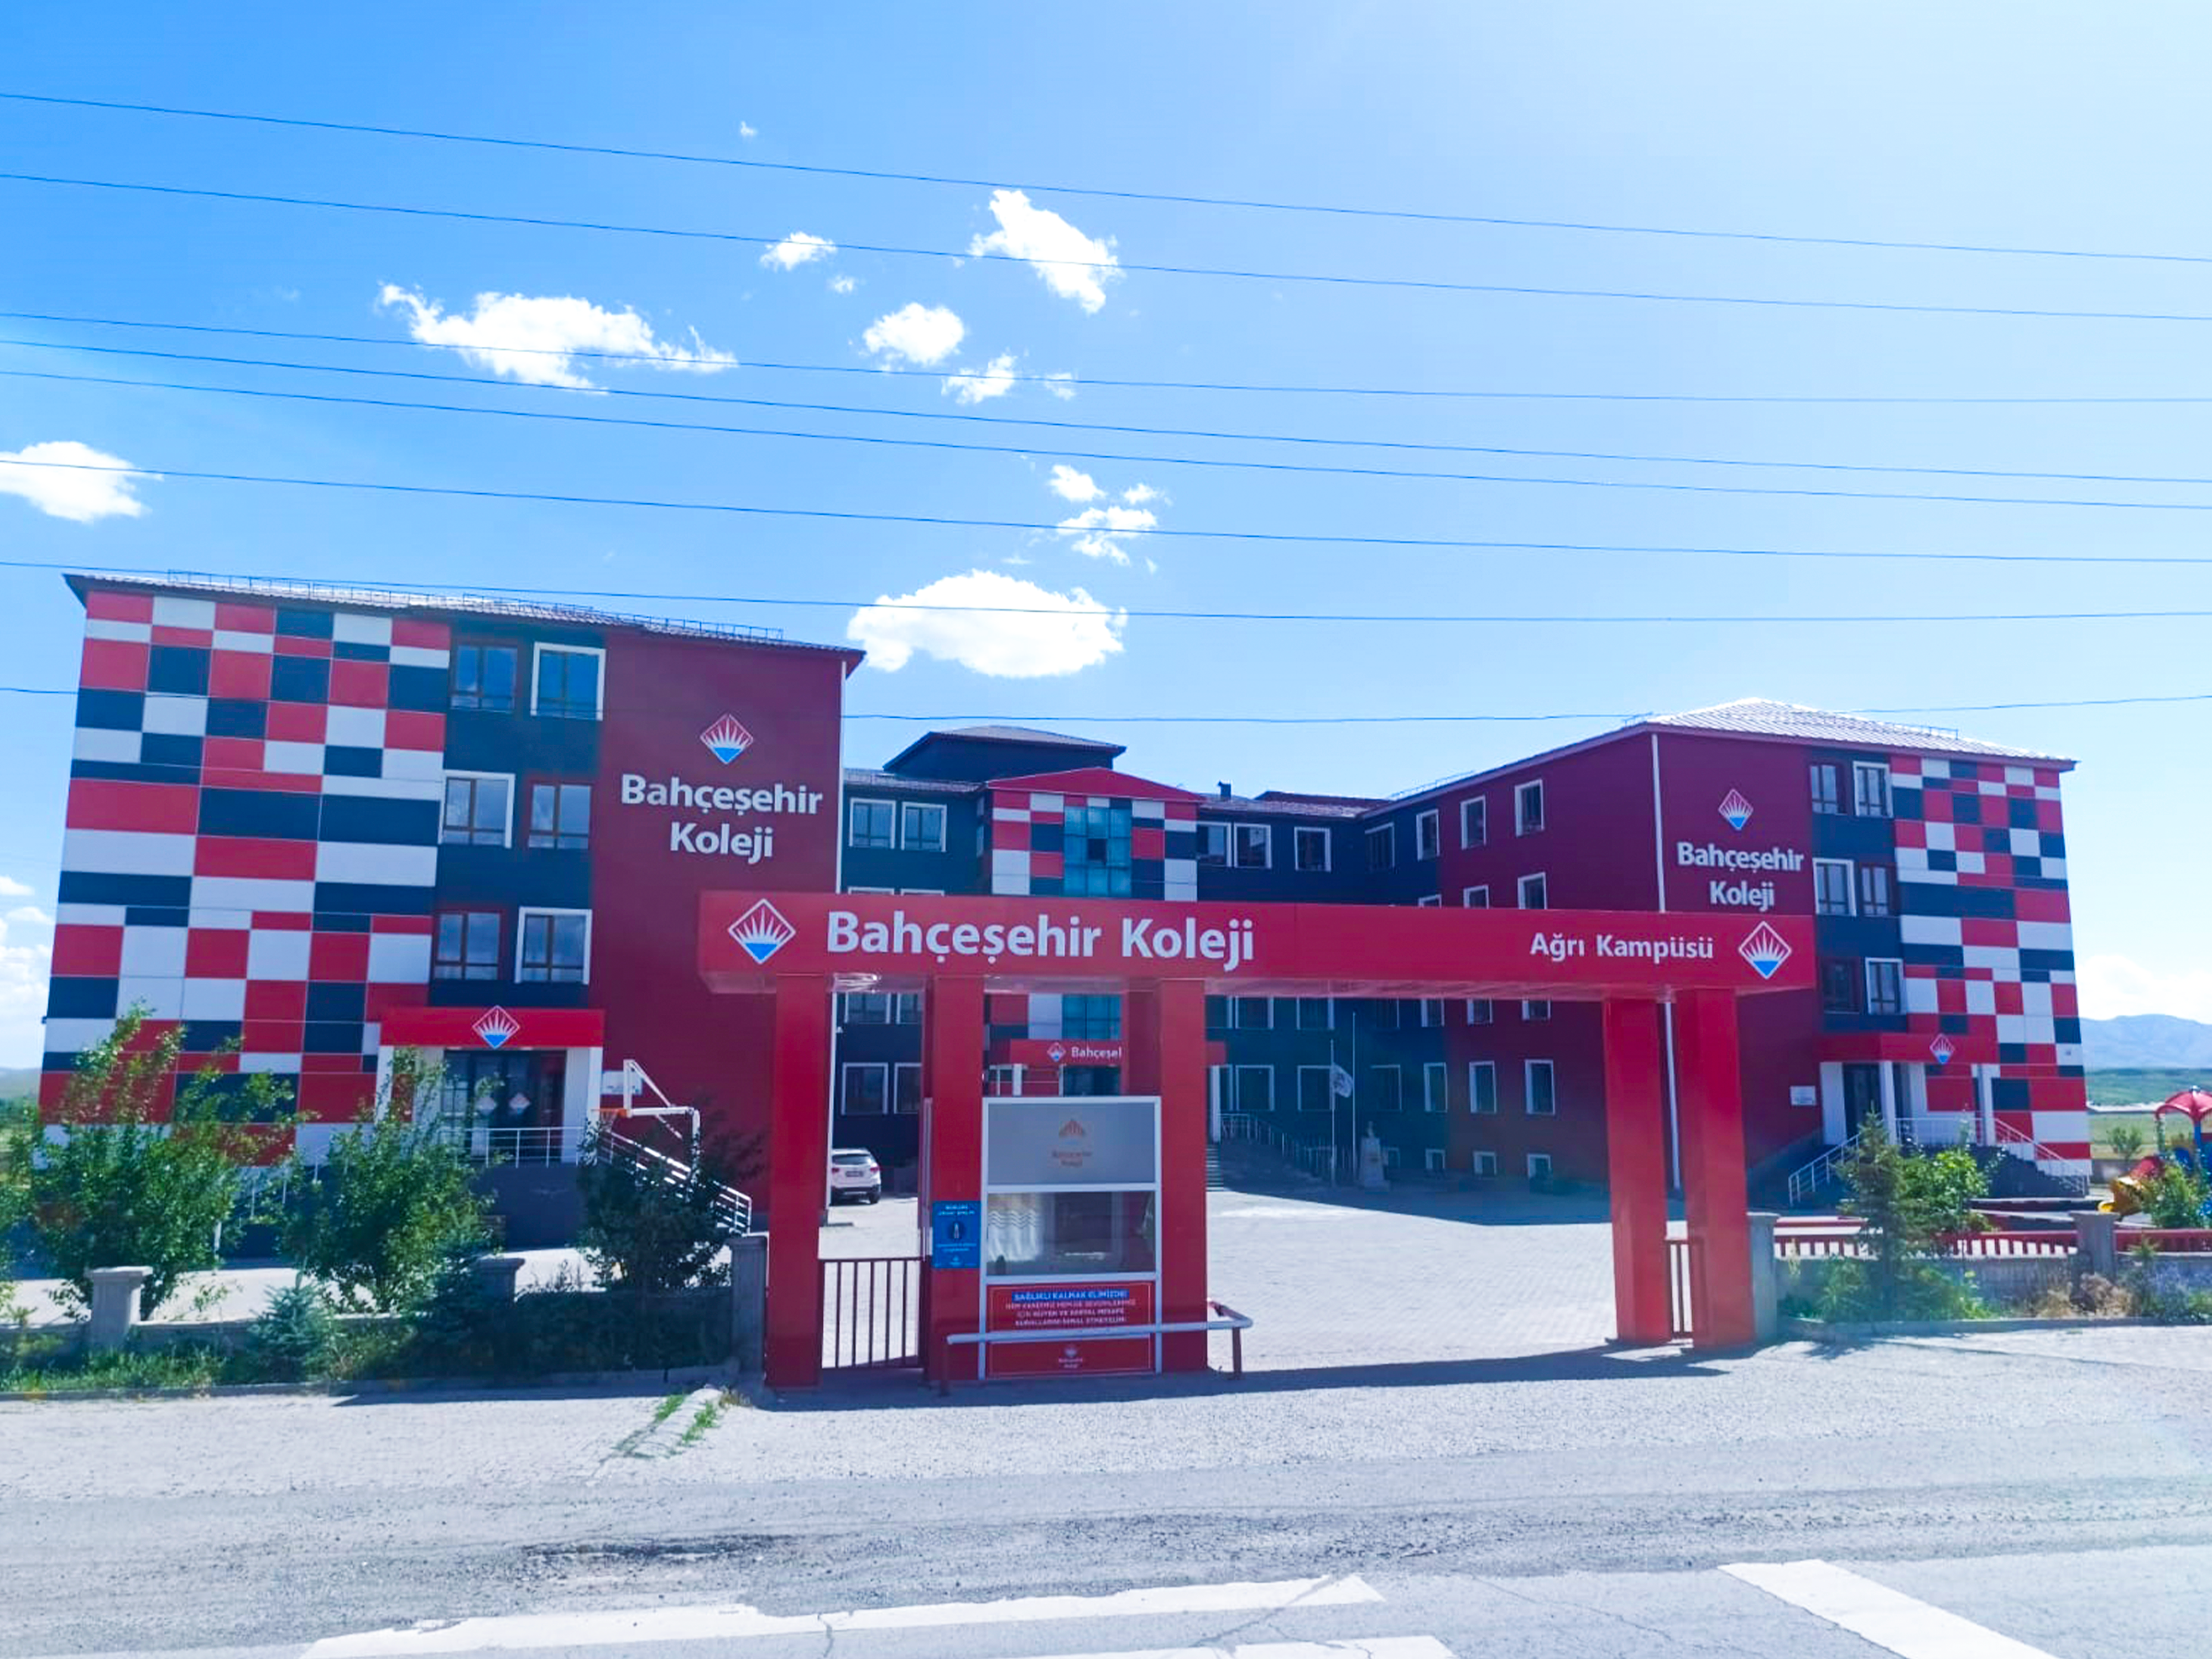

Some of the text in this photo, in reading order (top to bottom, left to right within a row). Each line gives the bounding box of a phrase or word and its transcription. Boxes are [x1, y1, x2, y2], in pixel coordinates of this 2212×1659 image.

[621, 773, 823, 816] Bahçeşehir
[670, 822, 773, 864] Koleji
[1677, 841, 1804, 873] Bahçeşehir
[1709, 880, 1775, 912] Koleji
[827, 910, 1254, 972] Bahçeşehir Koleji
[1530, 932, 1714, 964] Ağrı Kampüsü
